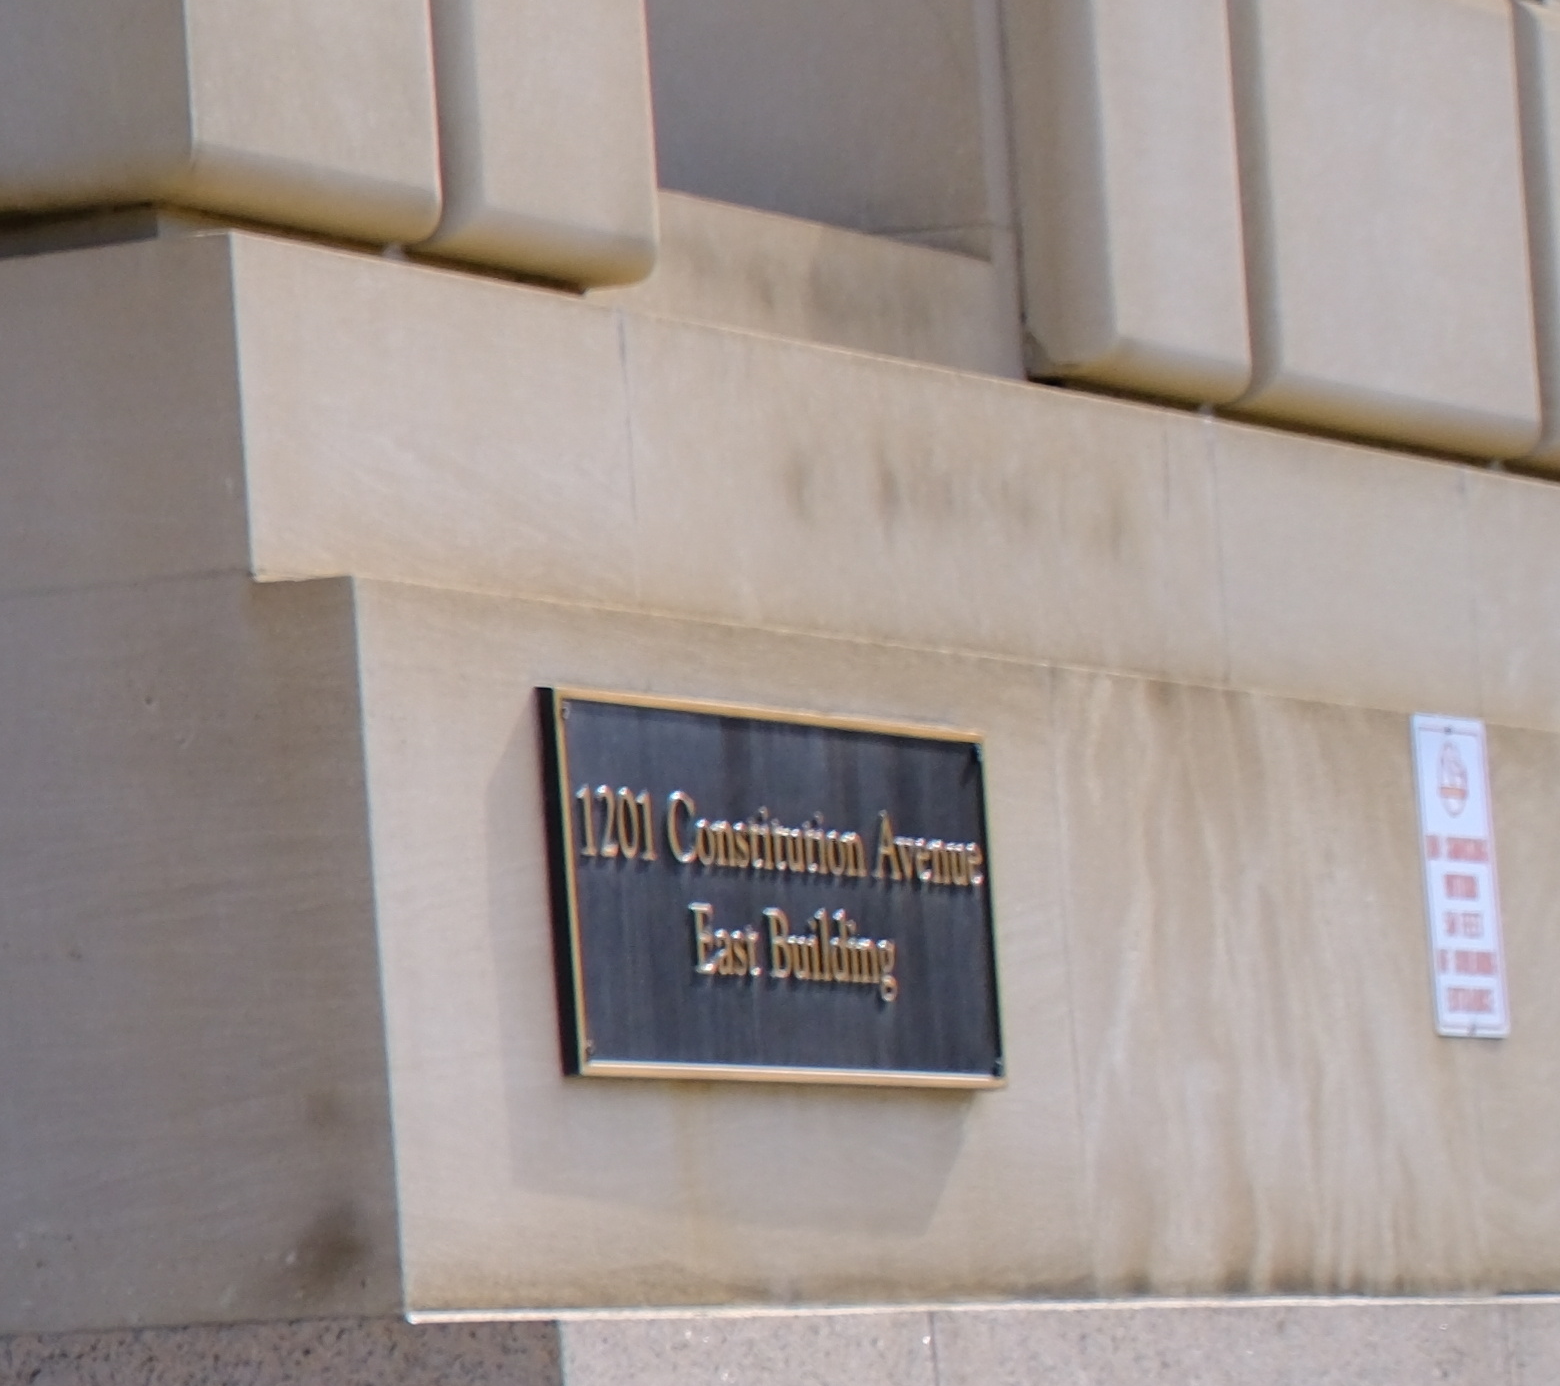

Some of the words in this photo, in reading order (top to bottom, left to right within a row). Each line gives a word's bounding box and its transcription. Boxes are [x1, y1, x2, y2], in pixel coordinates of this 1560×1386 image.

[575, 784, 658, 861] 1201
[666, 790, 867, 879] Constitution
[873, 810, 984, 887] Avenue
[688, 902, 762, 977] East
[763, 907, 899, 1003] Building
